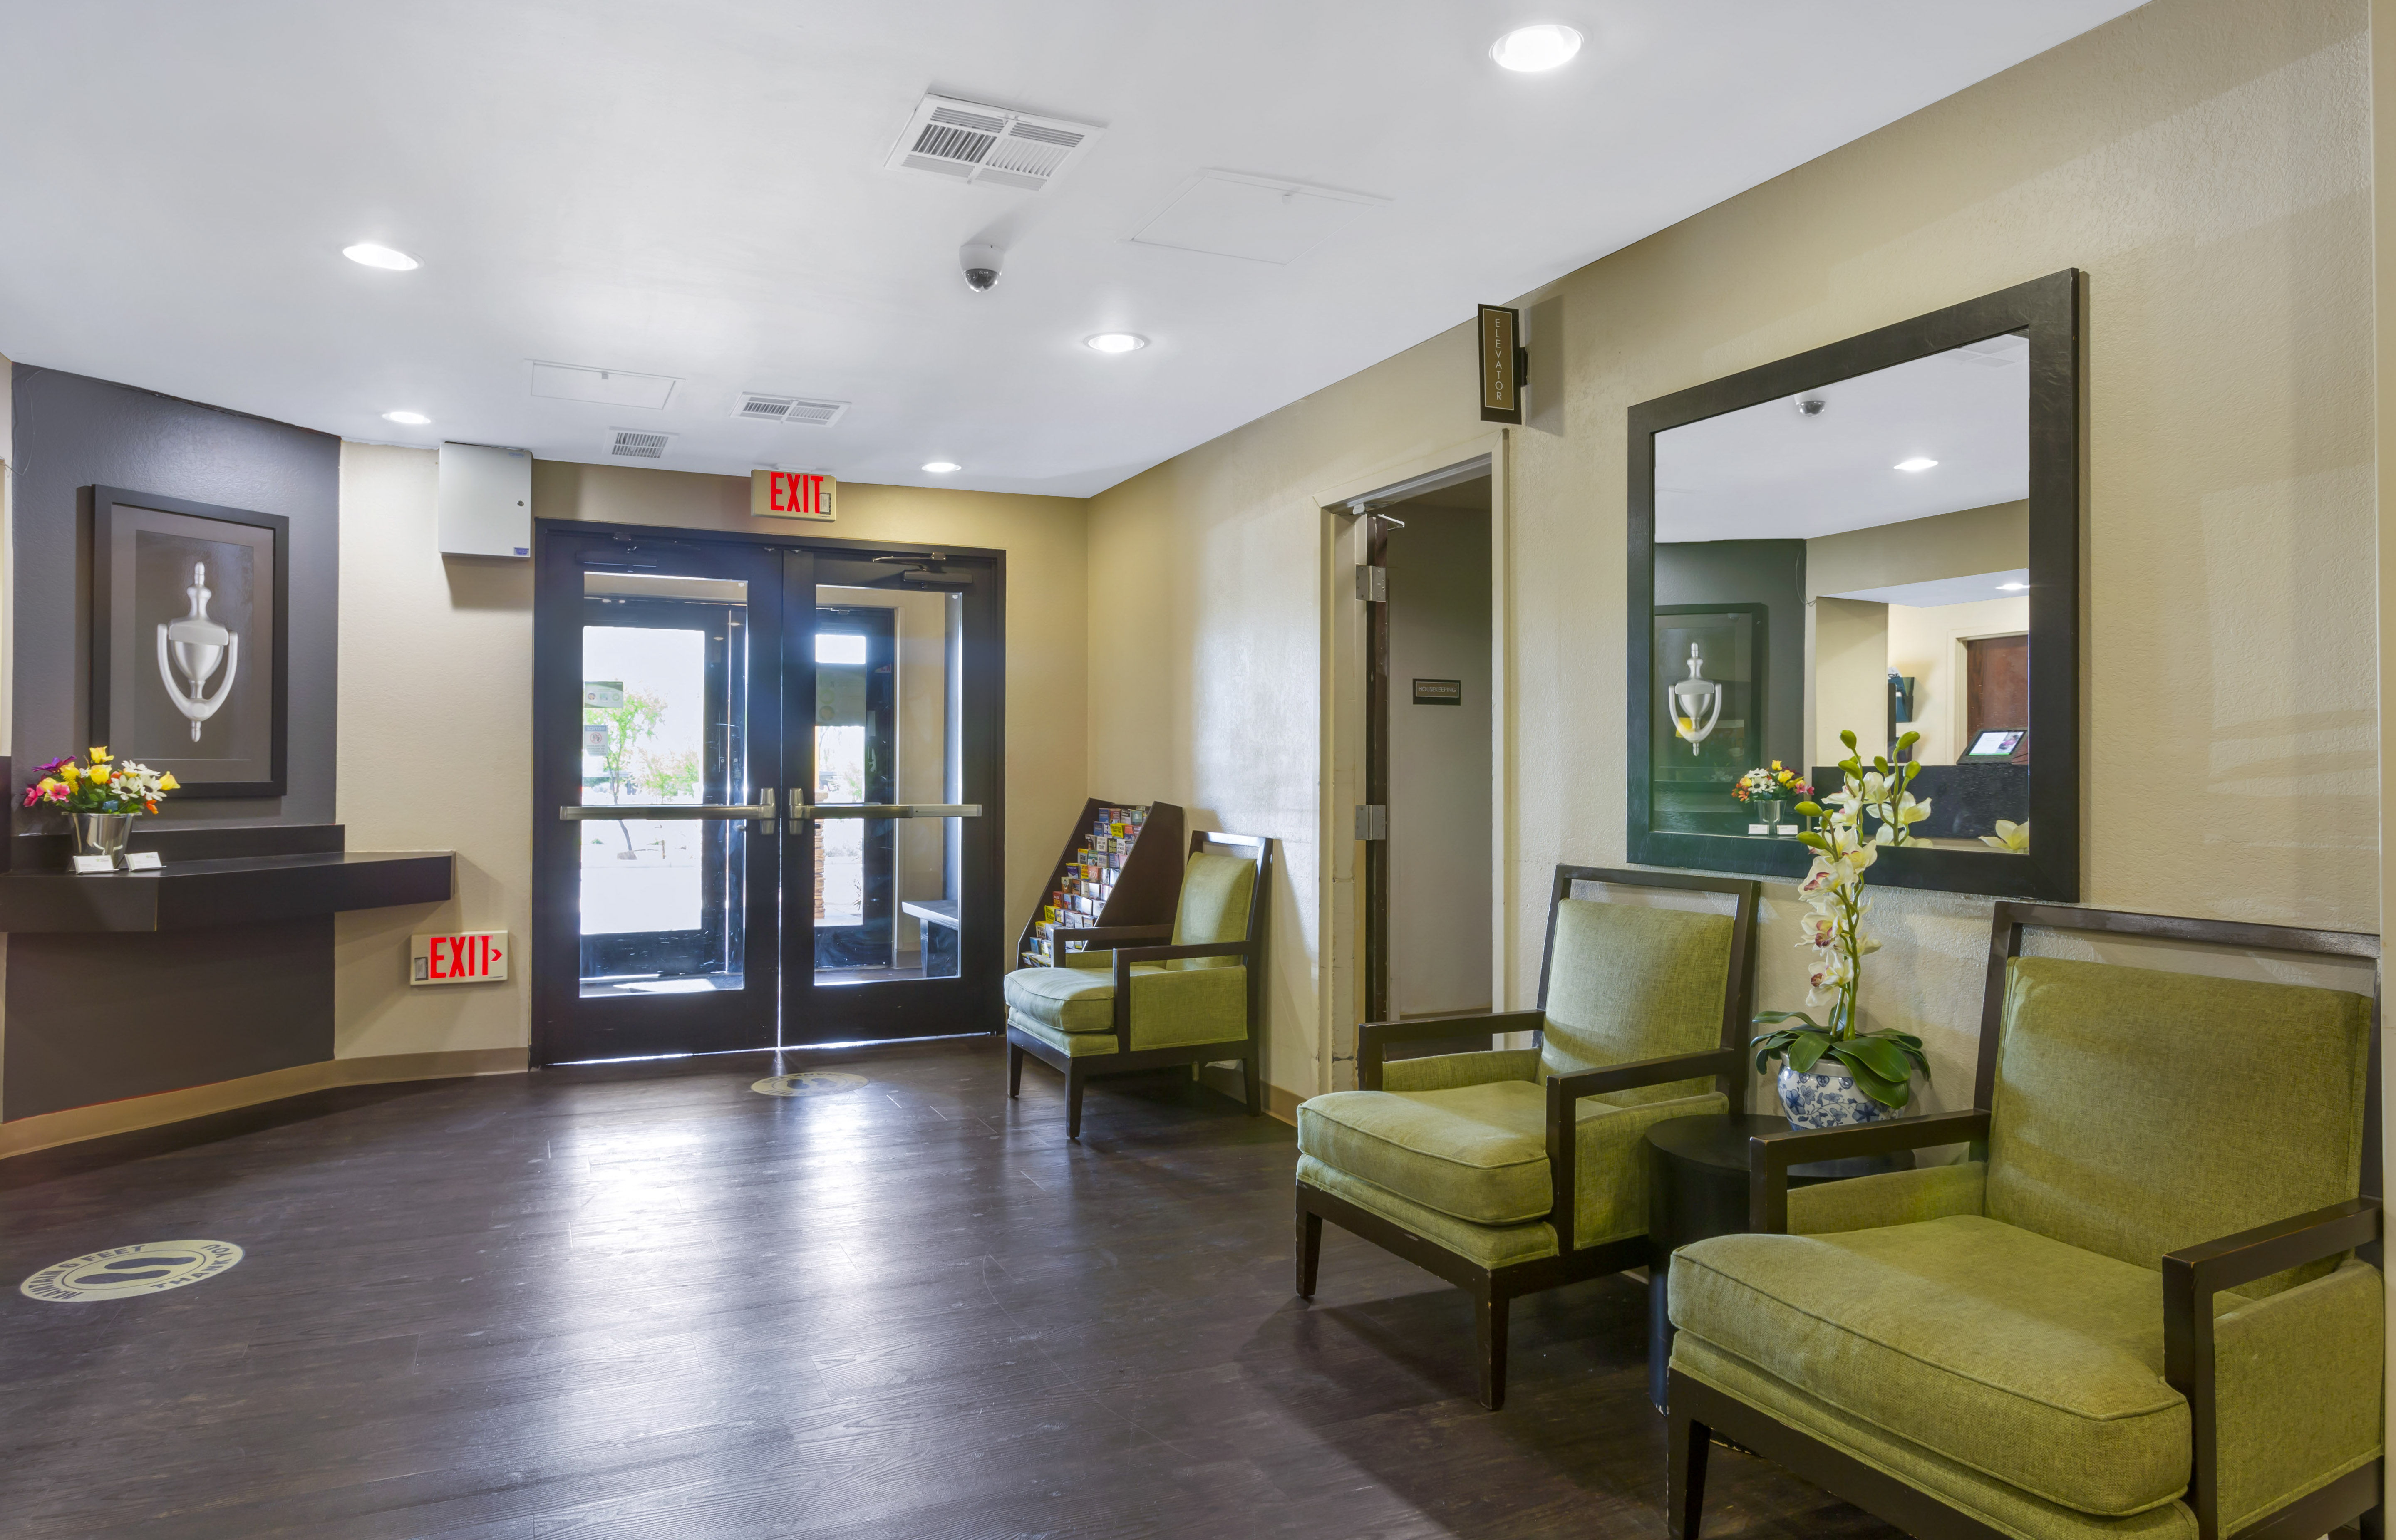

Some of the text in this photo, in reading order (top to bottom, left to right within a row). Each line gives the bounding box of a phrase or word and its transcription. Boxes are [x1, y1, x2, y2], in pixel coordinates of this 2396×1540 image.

[1495, 318, 1503, 401] ELEVATOR
[770, 471, 824, 514] EXIT
[430, 936, 494, 978] EXIT
[28, 1270, 84, 1300] MAINTAIN
[80, 1245, 146, 1262] FEET
[150, 1244, 233, 1289] THANK YOU
